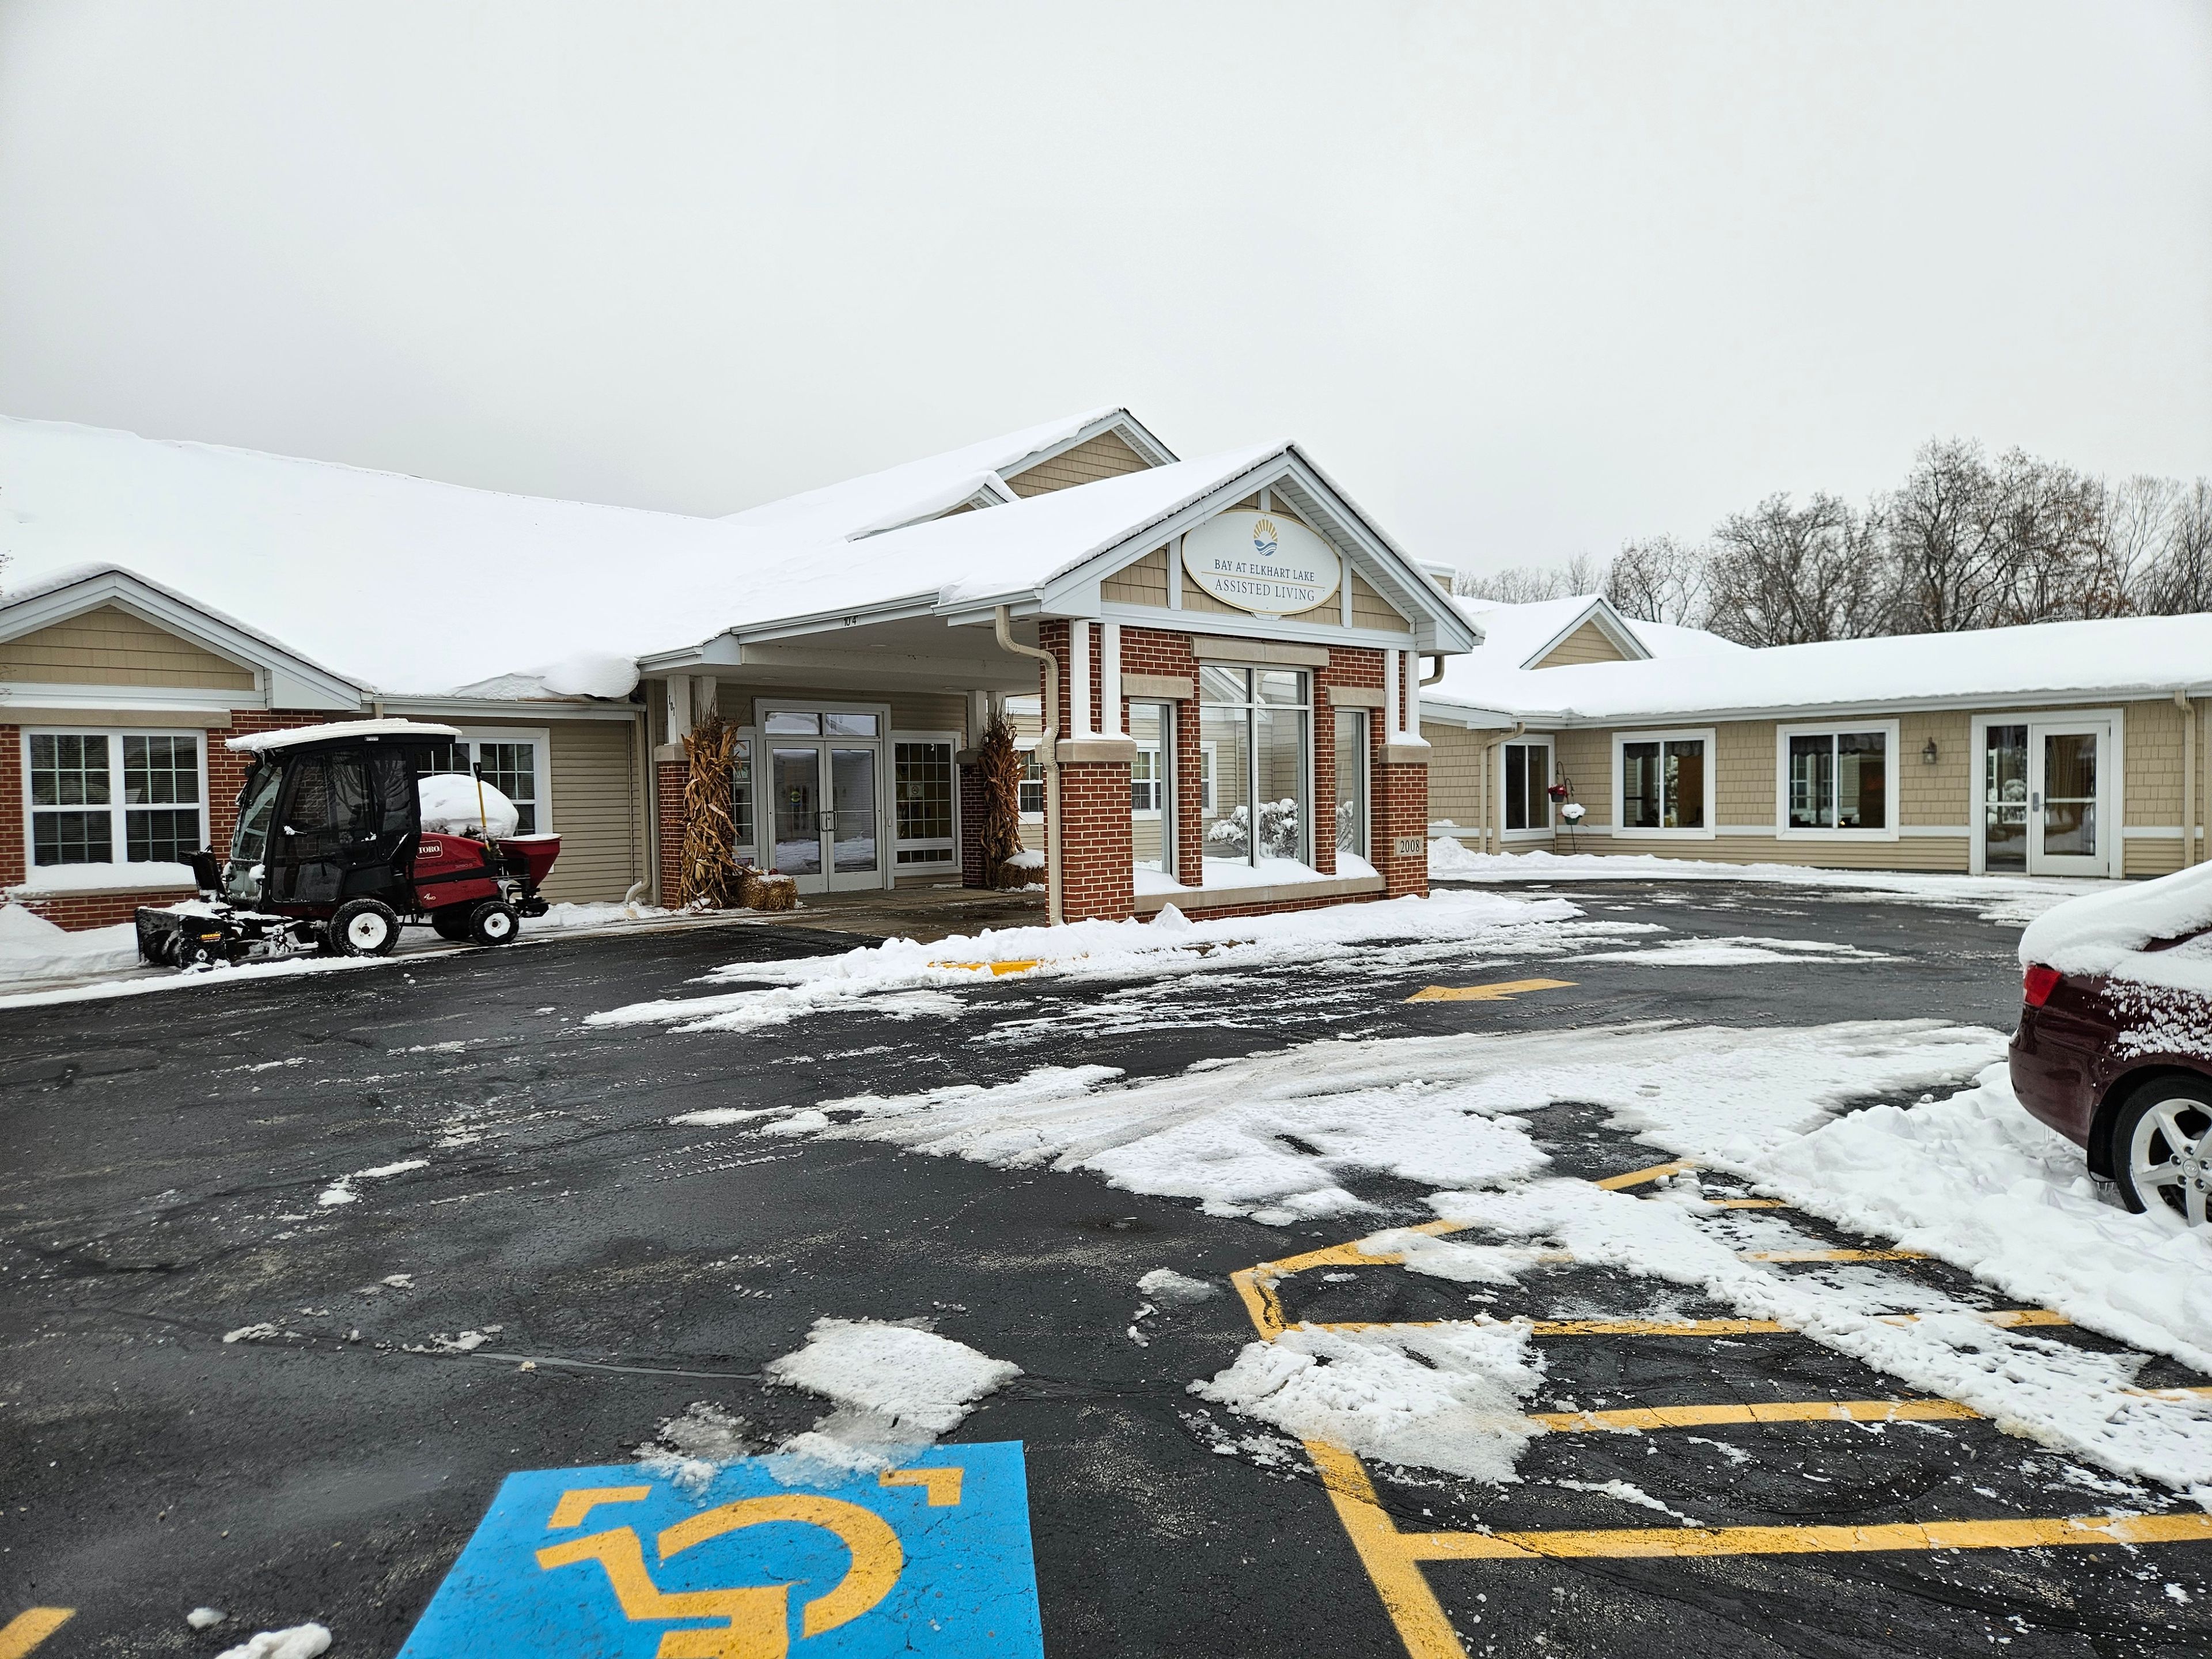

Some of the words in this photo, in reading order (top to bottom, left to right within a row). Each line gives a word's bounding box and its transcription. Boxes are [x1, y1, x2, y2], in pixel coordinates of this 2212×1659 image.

[1214, 559, 1233, 571] BAY
[1236, 562, 1247, 573] AT
[1250, 564, 1290, 578] ELKHART
[1293, 570, 1315, 582] LAKE
[1215, 578, 1271, 596] ASSISTED
[1275, 585, 1315, 601] LIVING
[418, 845, 440, 854] TORO
[1400, 839, 1420, 853] 2008
